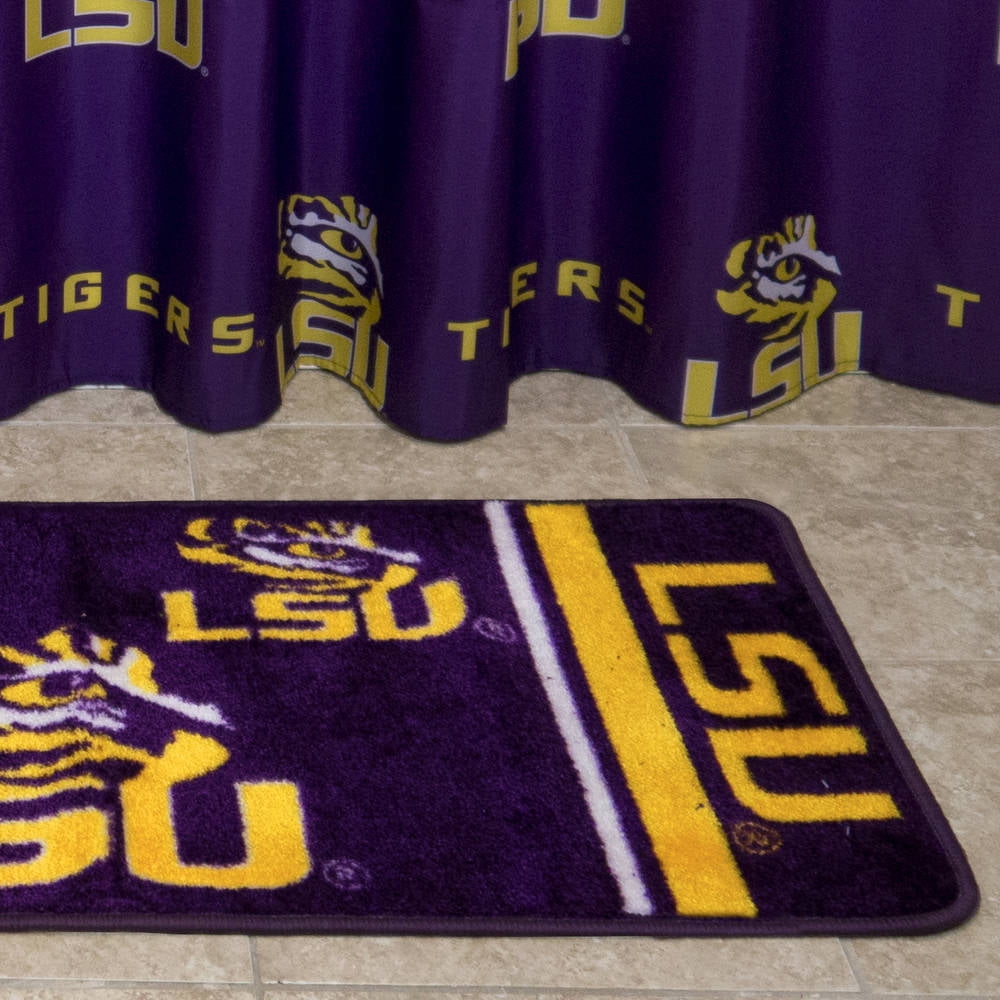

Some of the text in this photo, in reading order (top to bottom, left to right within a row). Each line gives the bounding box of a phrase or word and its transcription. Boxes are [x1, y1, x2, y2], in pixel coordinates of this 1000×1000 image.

[681, 310, 863, 426] LSU
[161, 577, 468, 642] LSU
[633, 562, 904, 824] LSU
